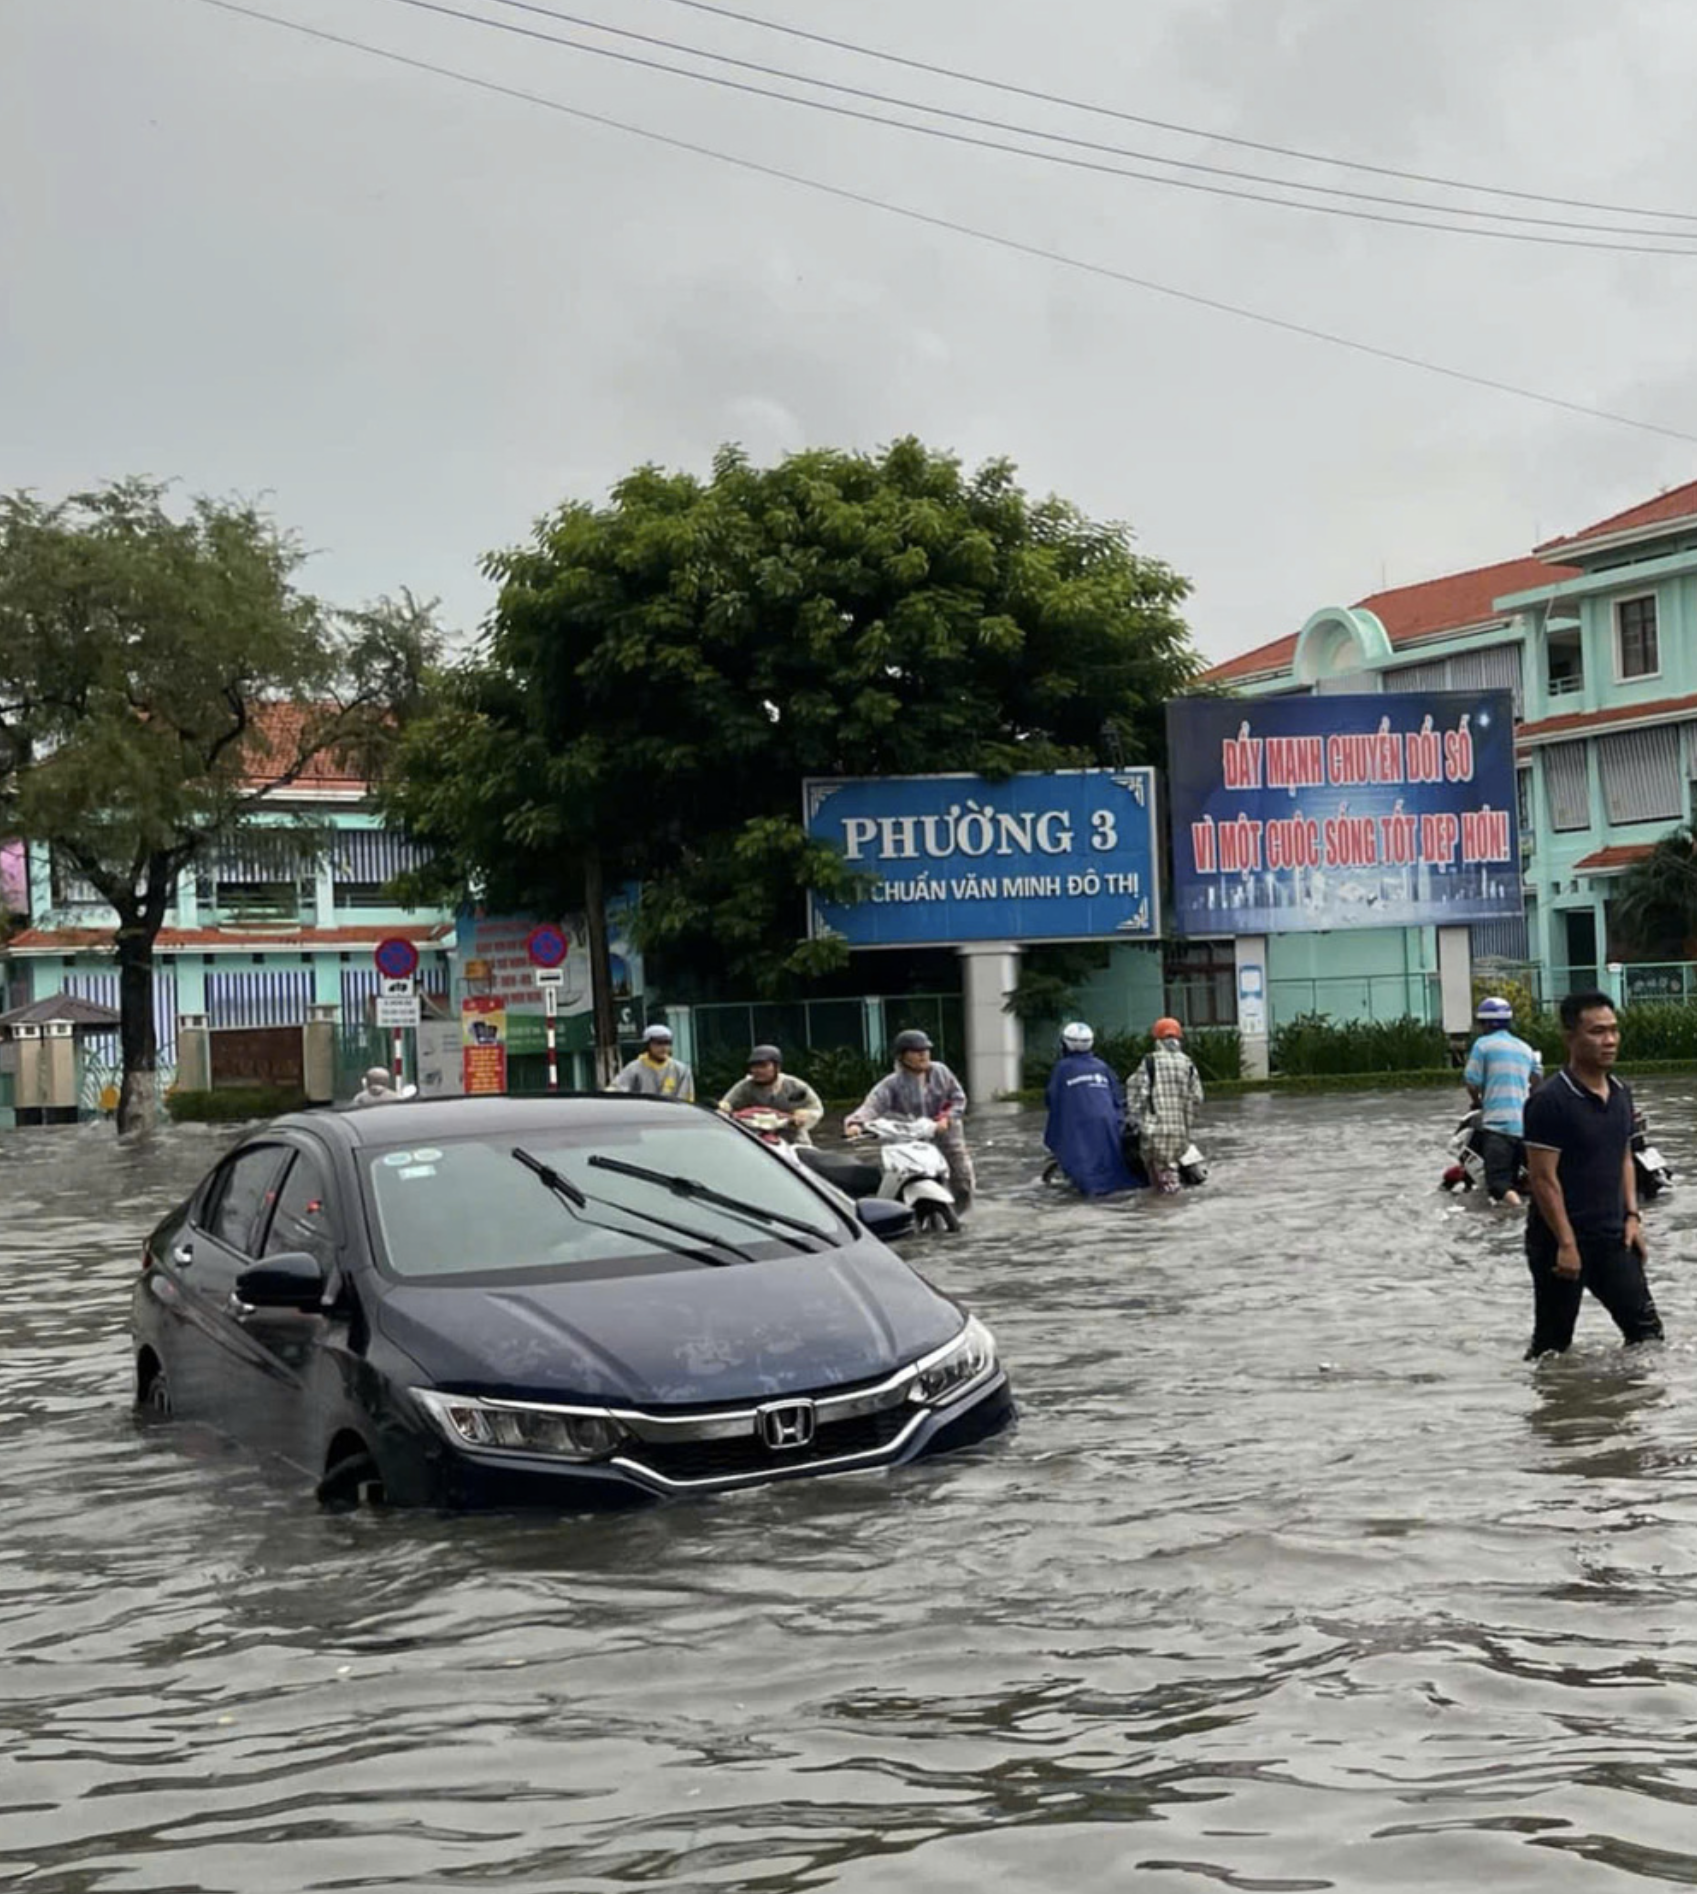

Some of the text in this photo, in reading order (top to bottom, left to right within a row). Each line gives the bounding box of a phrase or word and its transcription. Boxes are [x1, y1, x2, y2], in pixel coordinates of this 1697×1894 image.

[1223, 714, 1474, 797] ĐẨY MẠNH CHUYỂN ĐỔI SỐ
[841, 799, 1119, 860] PHƯỜNG 3
[1191, 798, 1511, 881] VÌ MỘT CUỘC SỐNG TỐT ĐẸP HƠN!
[951, 872, 998, 900] VĂN
[1002, 875, 1061, 899] MINH
[1066, 868, 1100, 896] ĐÔ
[1104, 872, 1140, 899] THỊ
